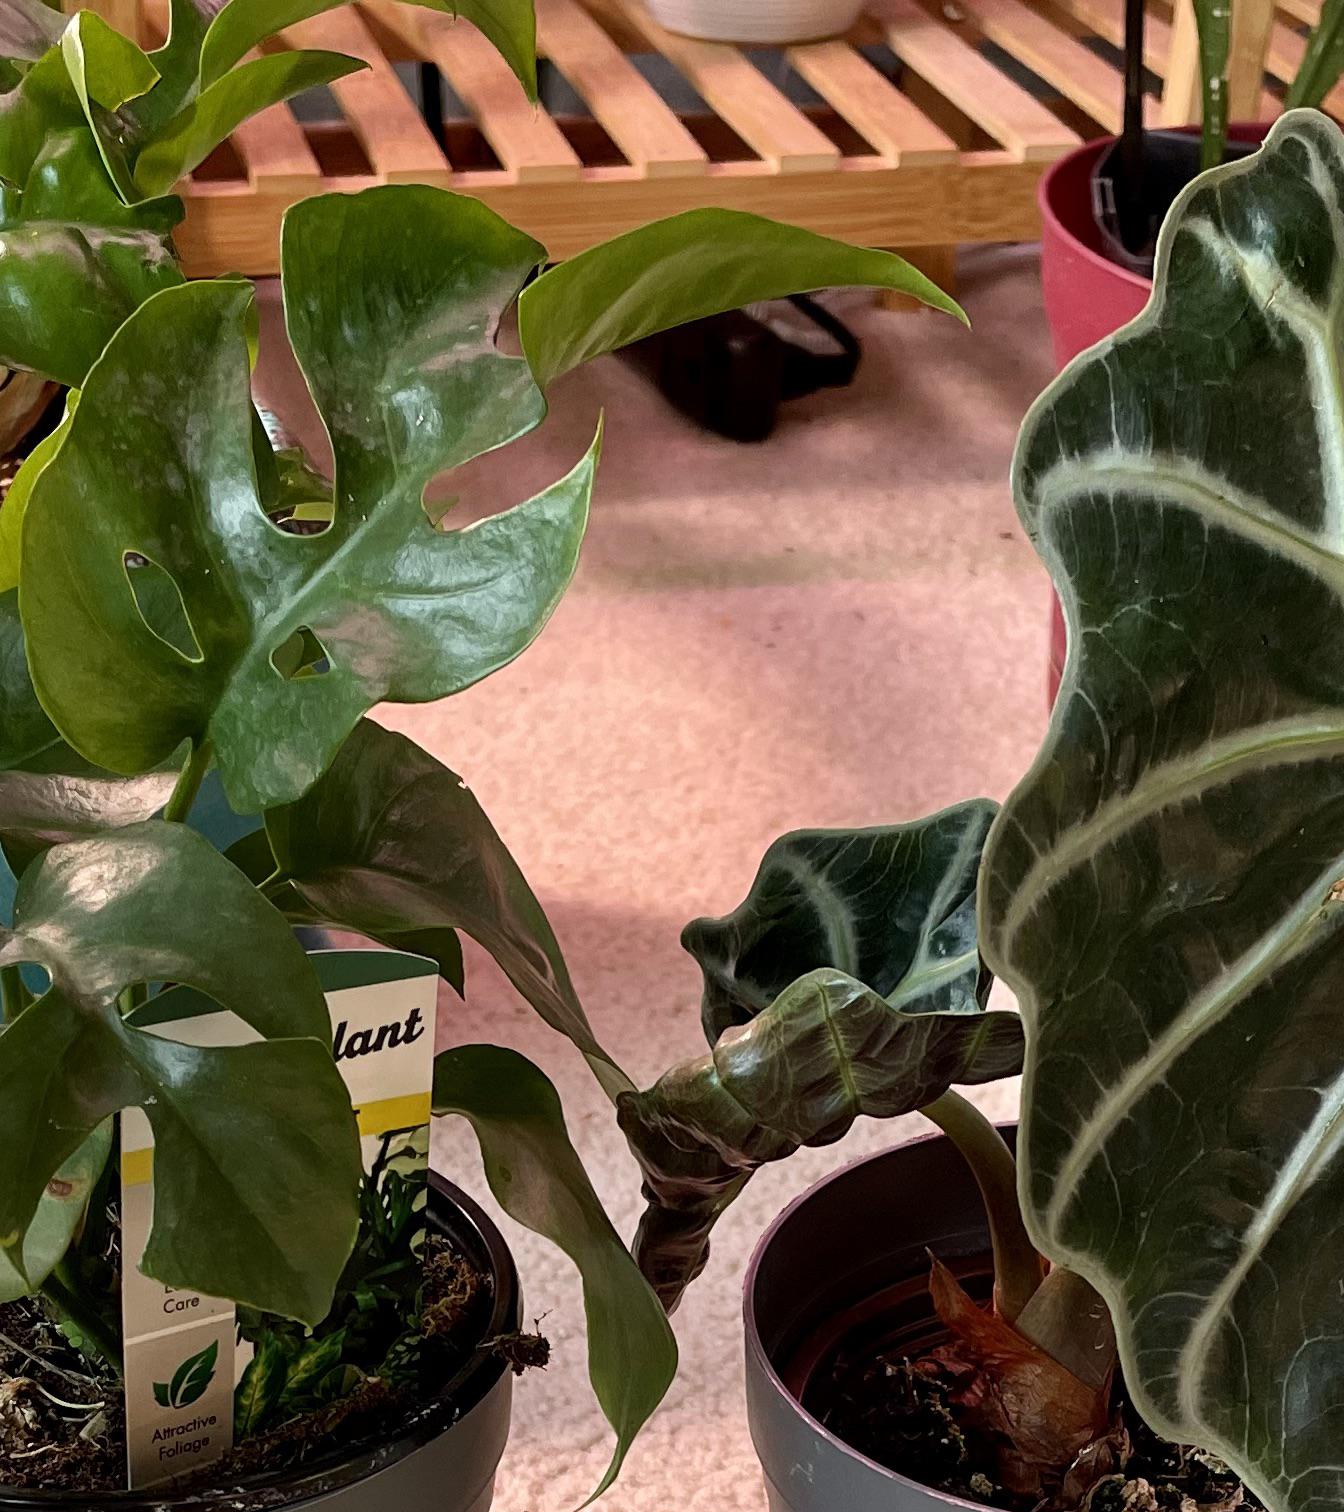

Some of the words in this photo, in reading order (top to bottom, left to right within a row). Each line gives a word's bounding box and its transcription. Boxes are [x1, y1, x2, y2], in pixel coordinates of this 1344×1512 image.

[333, 1007, 425, 1063] lant
[162, 1295, 201, 1314] Care
[151, 1414, 218, 1445] Attractive
[158, 1435, 211, 1462] Foliage
